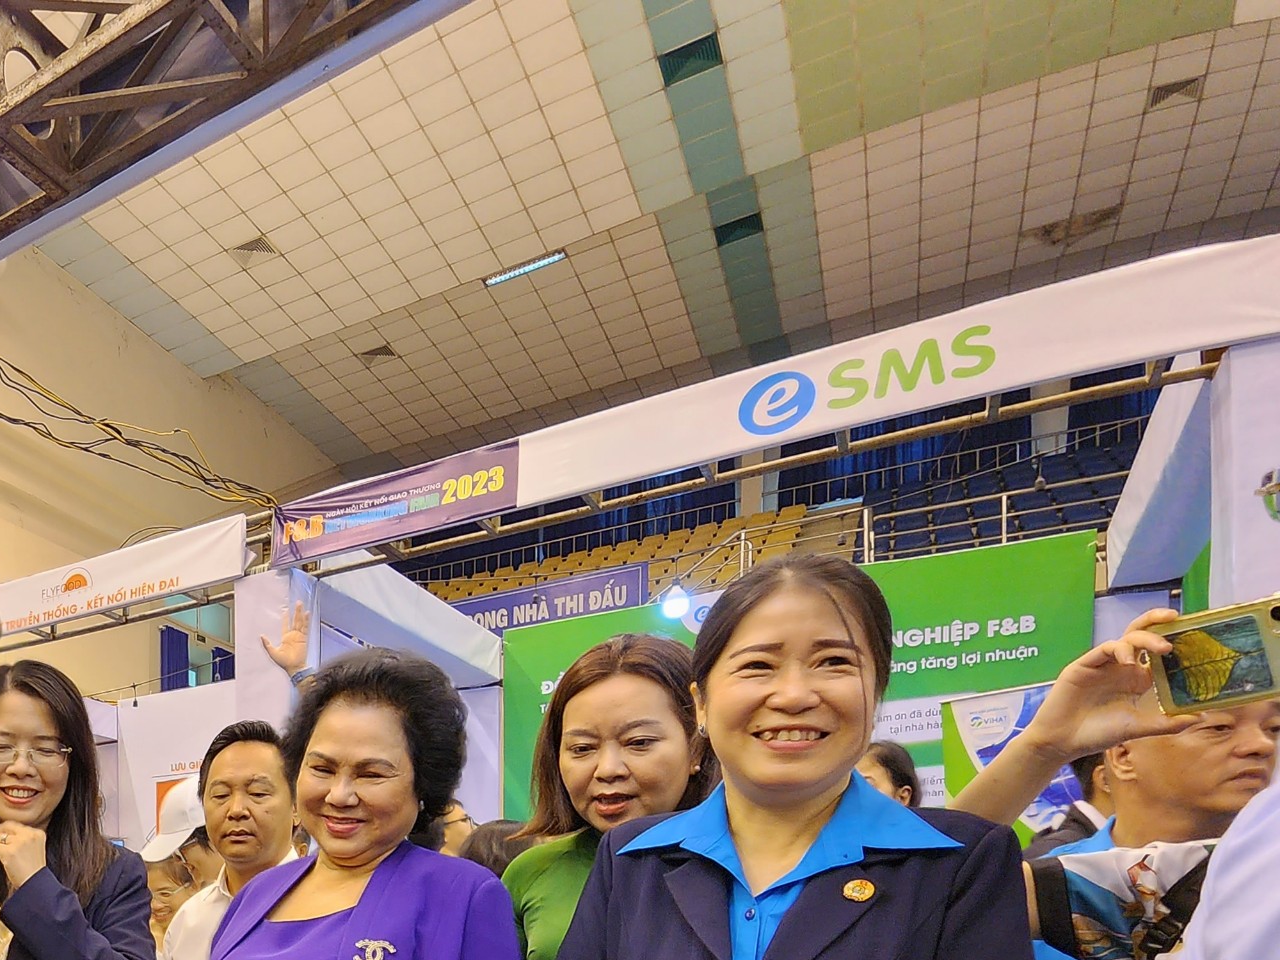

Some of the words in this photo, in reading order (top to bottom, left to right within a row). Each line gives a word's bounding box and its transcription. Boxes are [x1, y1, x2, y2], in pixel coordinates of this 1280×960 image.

[283, 515, 324, 545] F&B
[441, 465, 505, 505] 2023
[360, 500, 373, 511] KẾT
[373, 495, 388, 507] NỐI
[389, 491, 408, 502] GIAO
[409, 482, 441, 496] THƯƠNG
[6, 609, 40, 631] TRUYỀN
[42, 602, 78, 620] THỐNG
[86, 596, 104, 611] KẾT
[107, 588, 127, 604] NỐI
[130, 582, 156, 599] HIỆN
[158, 576, 179, 594] ĐẠI
[41, 580, 82, 599] FLYFOOD
[512, 596, 550, 624] NHÀ
[554, 593, 584, 617] THI
[588, 579, 627, 610] ĐẤU
[987, 615, 1036, 638] F&B
[920, 655, 958, 670] tăng
[961, 651, 981, 667] lợi
[985, 646, 1039, 663] nhuận
